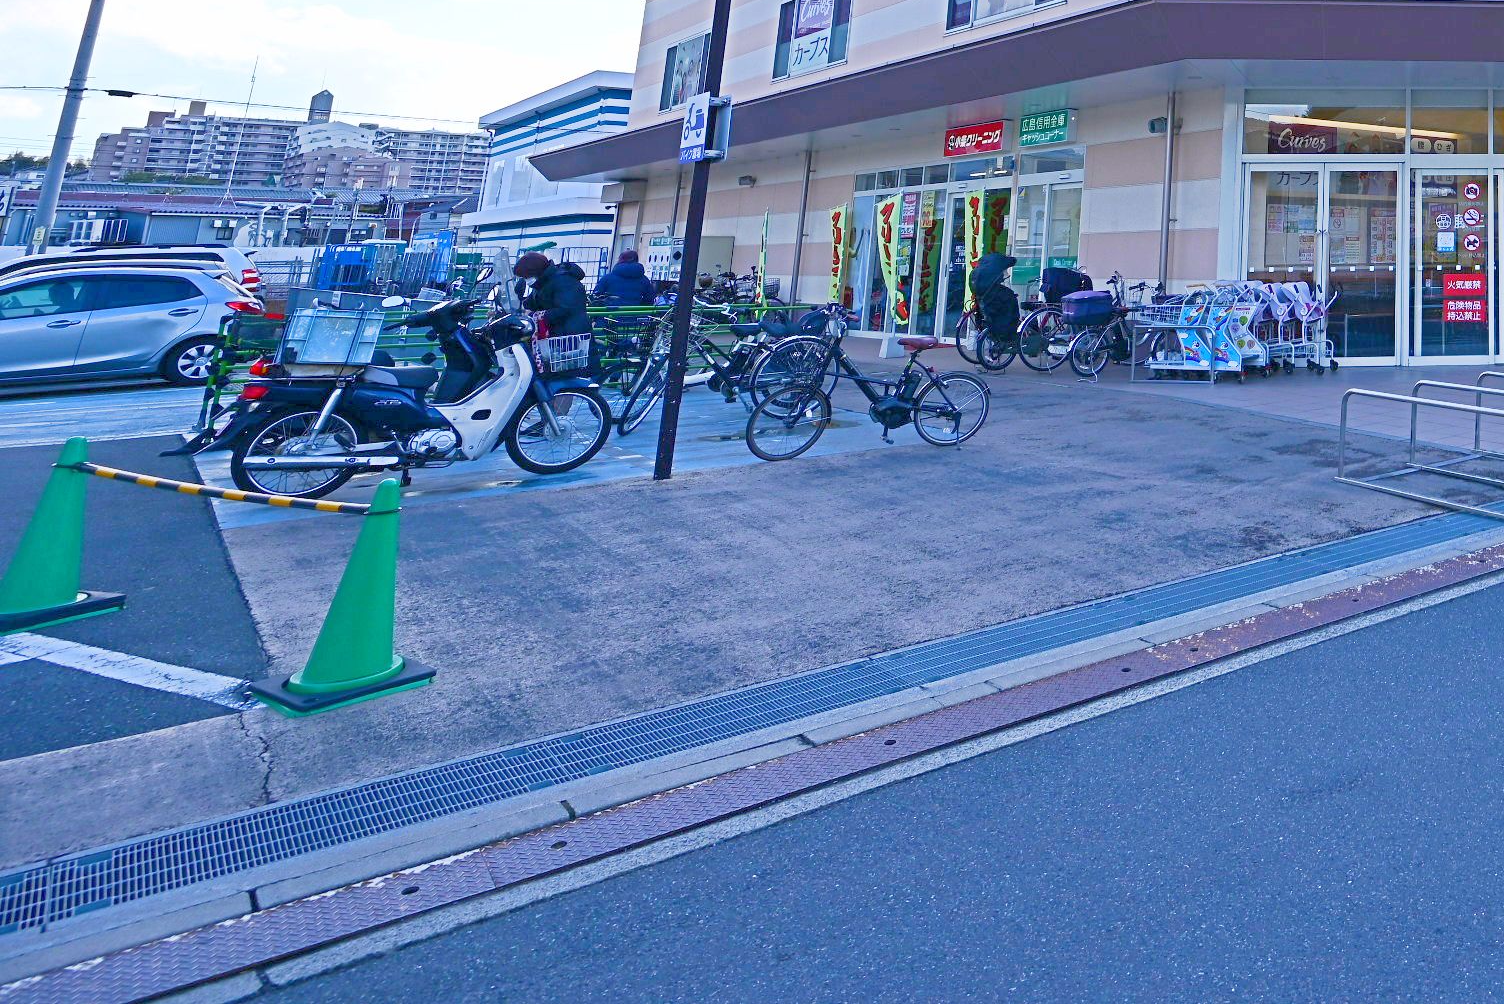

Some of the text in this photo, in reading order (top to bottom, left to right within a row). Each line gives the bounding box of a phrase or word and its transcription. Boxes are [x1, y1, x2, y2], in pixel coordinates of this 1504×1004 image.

[792, 36, 828, 66] カーブス
[1022, 114, 1066, 132] 広島信用金庫
[1277, 127, 1327, 152] Curves
[1447, 280, 1481, 290] 火気厳禁
[1447, 300, 1482, 311] 危険物品
[1447, 311, 1482, 321] 持込禁止
